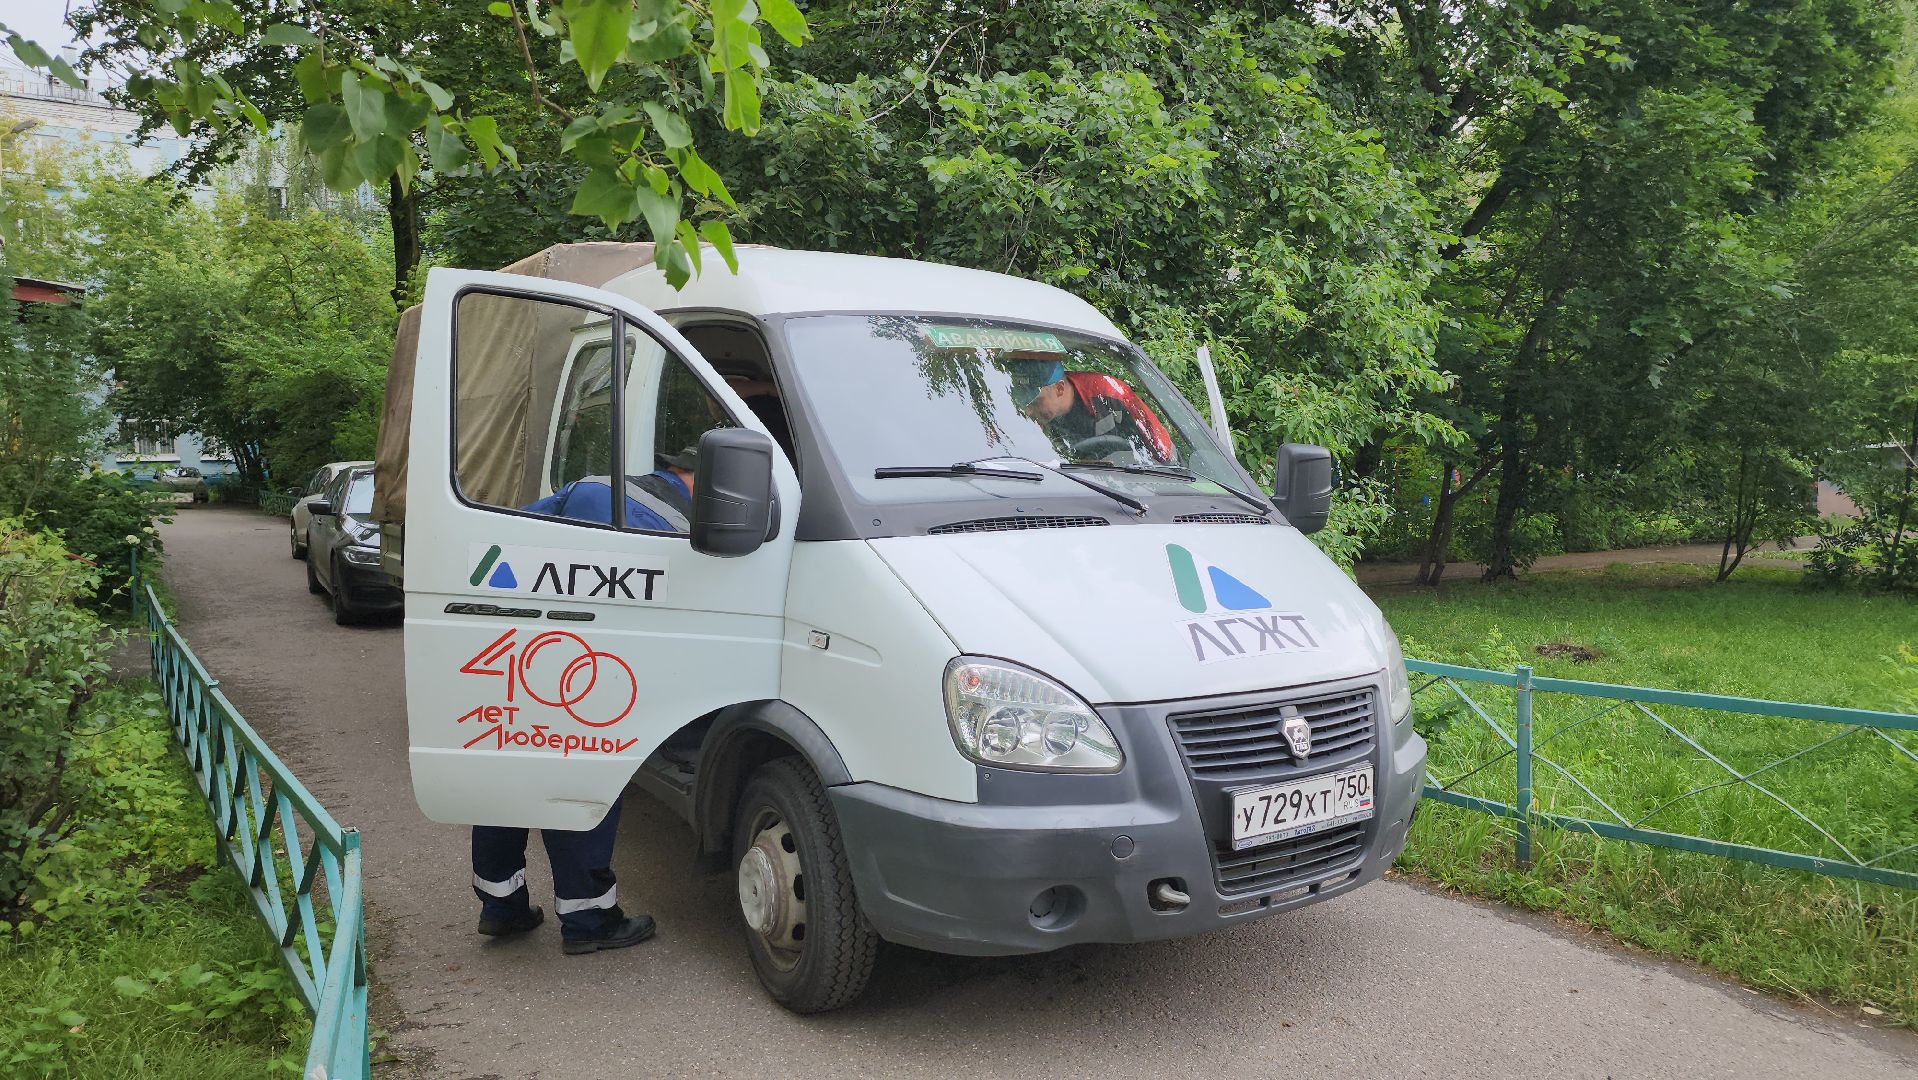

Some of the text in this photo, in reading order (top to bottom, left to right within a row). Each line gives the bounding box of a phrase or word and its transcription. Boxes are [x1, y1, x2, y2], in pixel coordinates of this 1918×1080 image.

[938, 331, 1062, 351] АВАРИЙНАЯ
[531, 562, 665, 601] ЛГЖТ
[1187, 615, 1320, 662] ЛГЖТ
[459, 627, 638, 728] 400
[463, 723, 639, 758] Люберцы
[1336, 773, 1368, 802] 750
